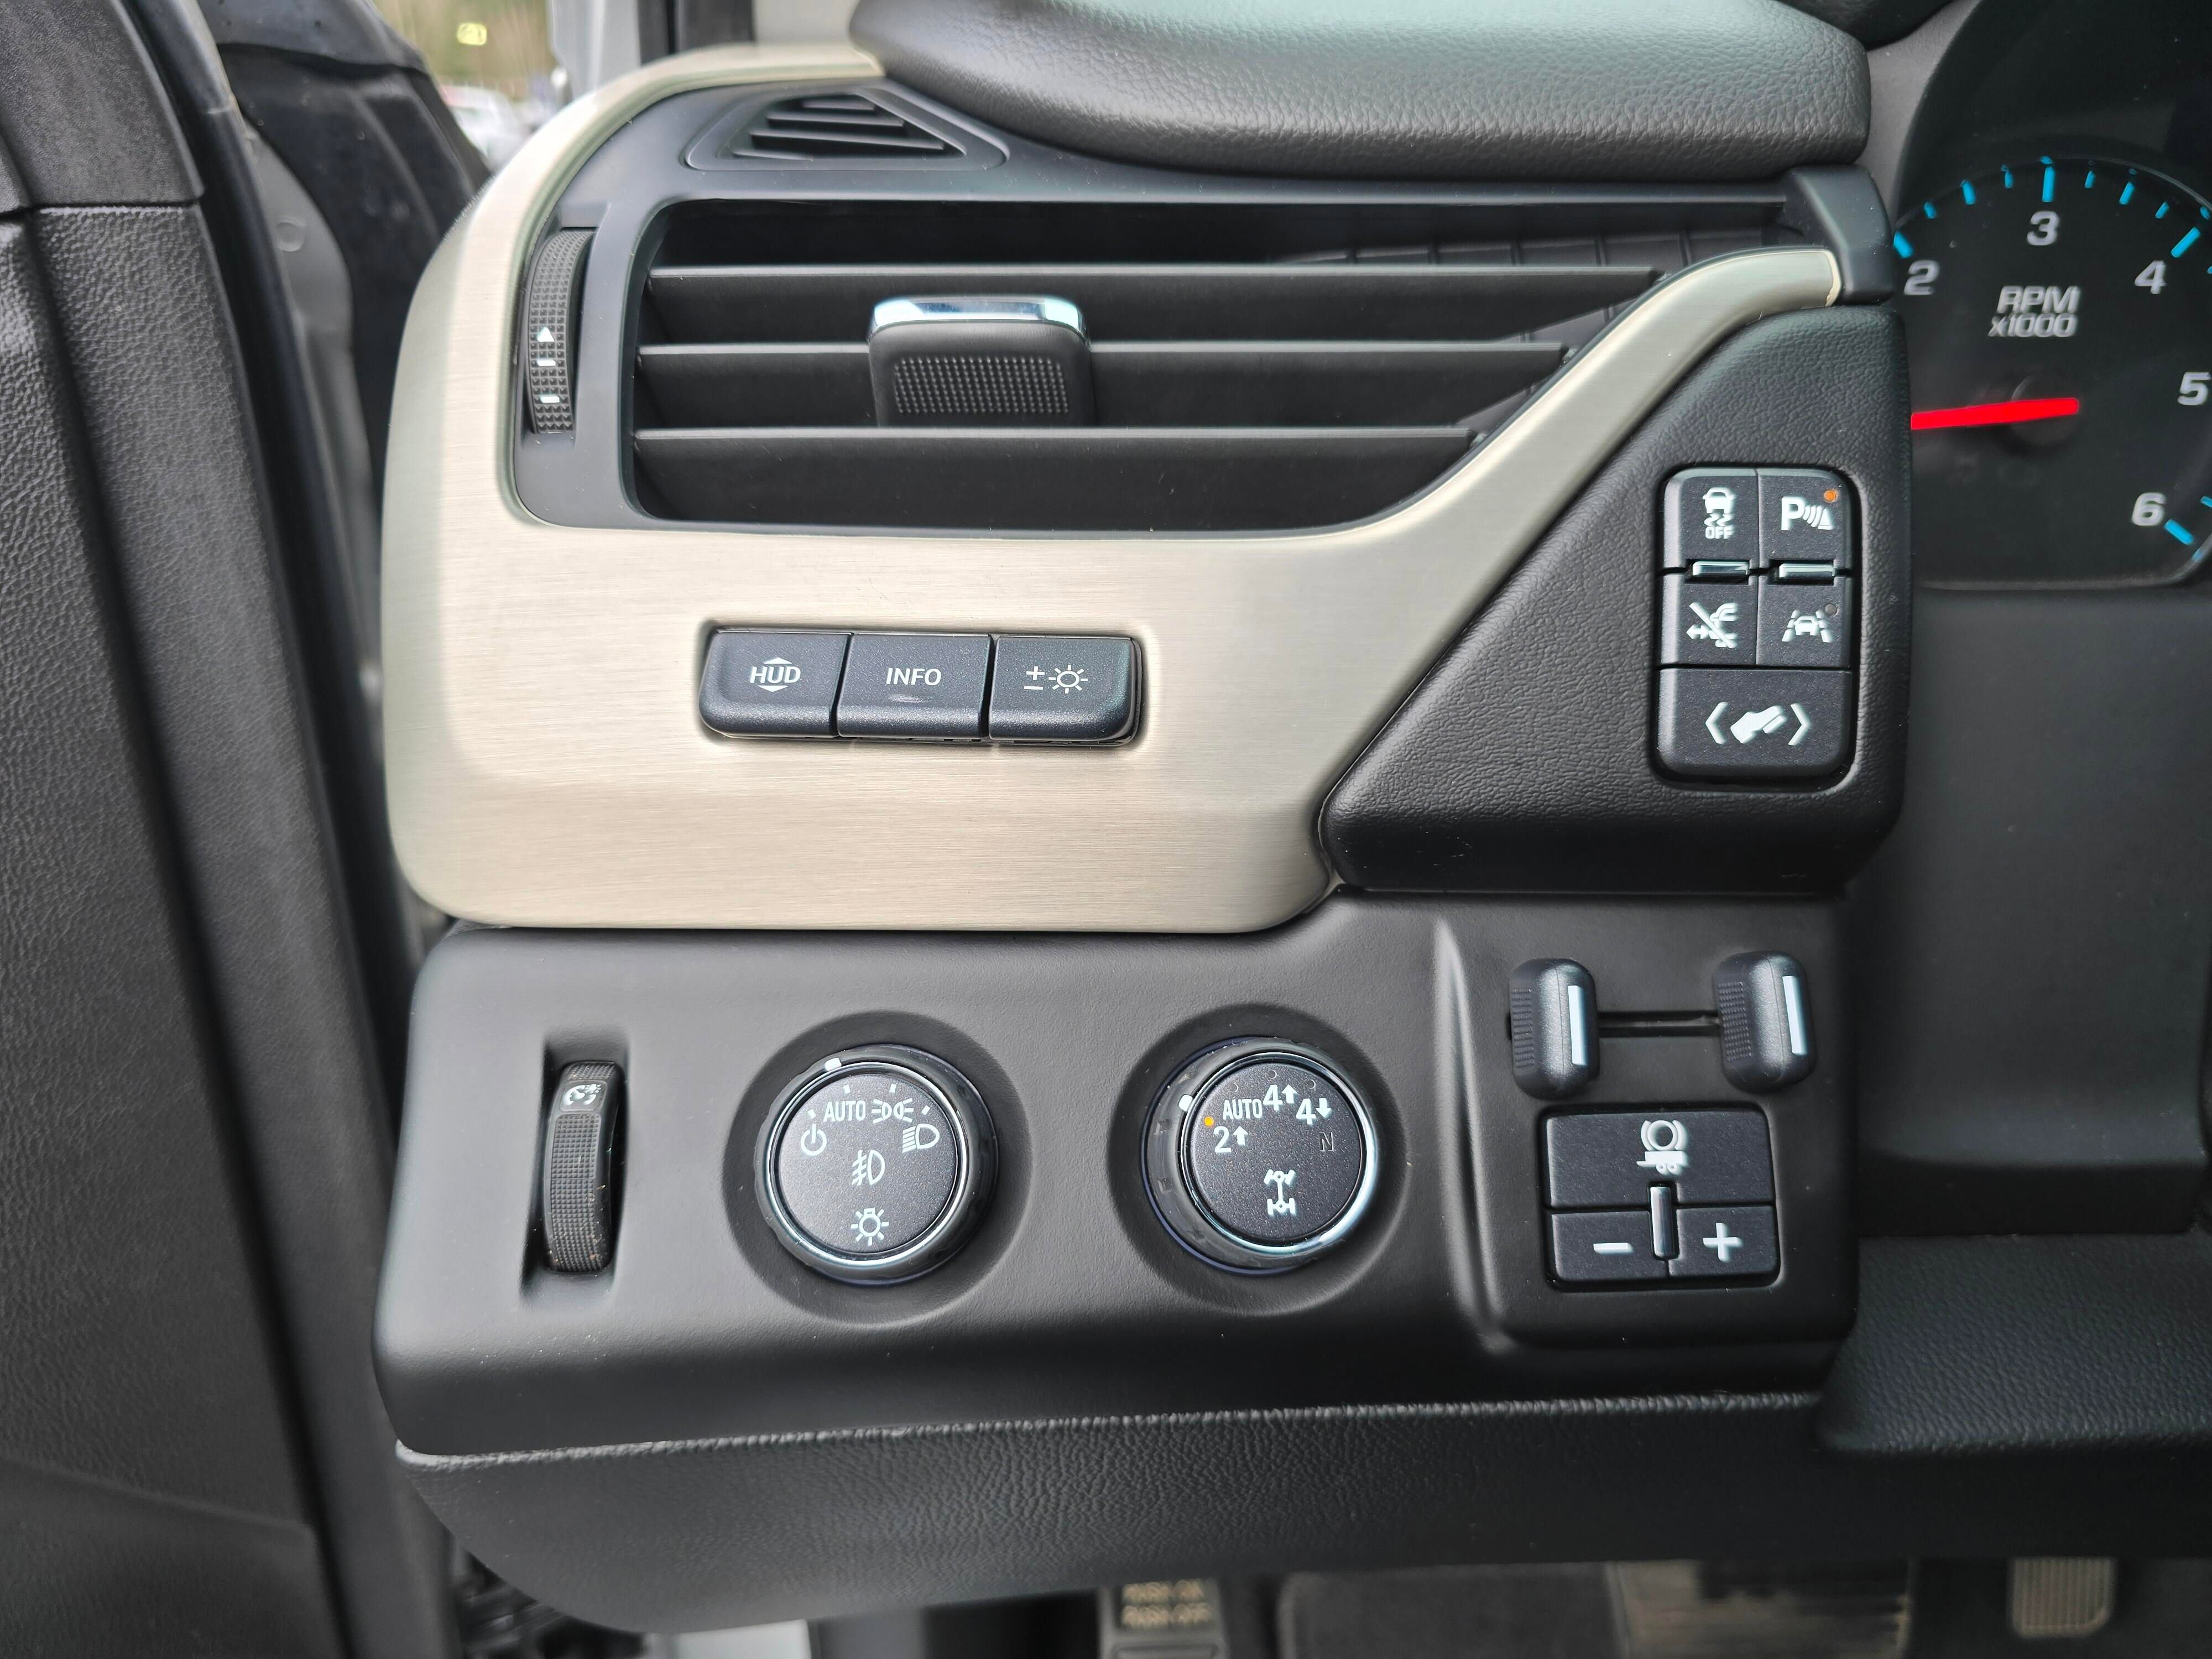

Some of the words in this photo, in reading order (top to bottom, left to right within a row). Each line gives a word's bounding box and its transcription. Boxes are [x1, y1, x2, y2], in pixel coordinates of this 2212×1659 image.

[2027, 211, 2059, 246] 3
[1903, 260, 1939, 296] 2
[2134, 260, 2166, 295] 4
[1996, 286, 2081, 313] RPM
[2178, 372, 2211, 406] 5
[2131, 492, 2167, 526] 6
[1705, 526, 1734, 539] OFF
[749, 665, 801, 684] HUD
[885, 667, 942, 686] INFO
[823, 1100, 866, 1123] AUTO
[1222, 1098, 1262, 1120] AUTO
[1263, 1084, 1283, 1112] 4
[1296, 1098, 1316, 1125] 4
[1213, 1125, 1232, 1154] 2
[1319, 1131, 1334, 1152] N
